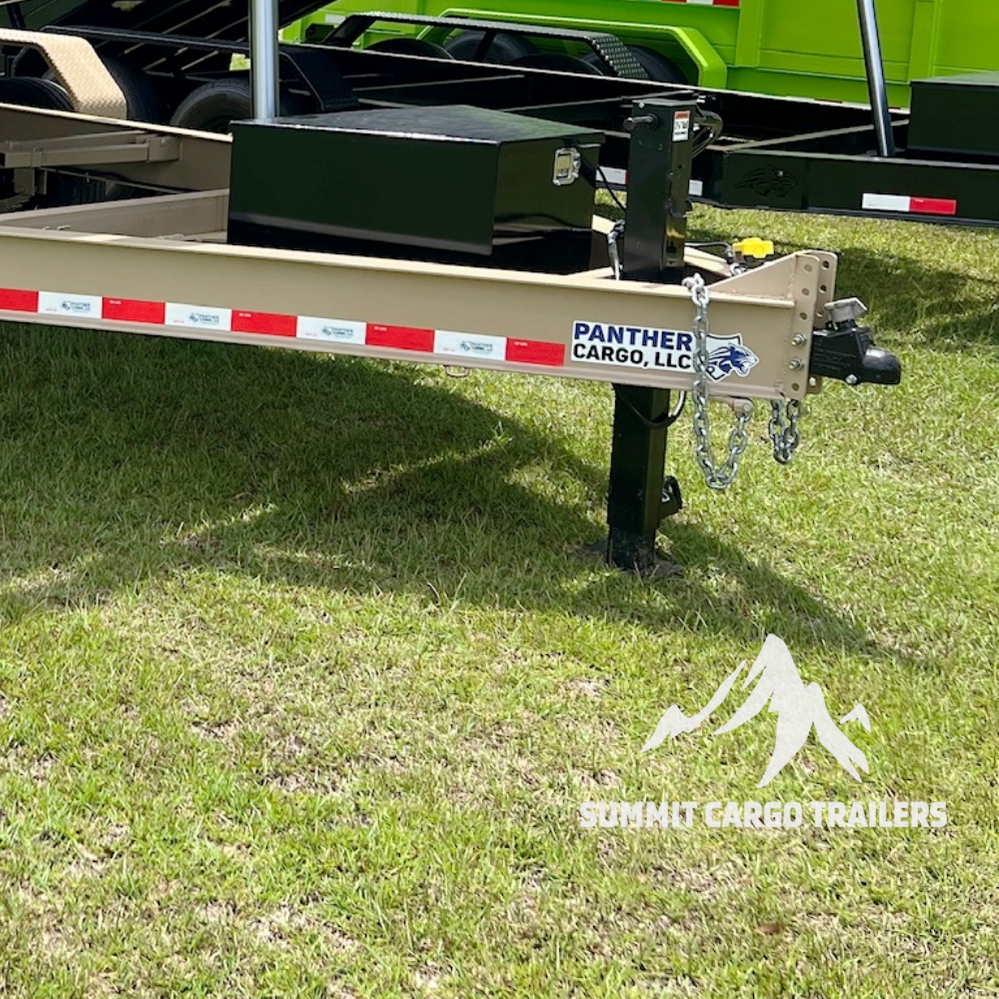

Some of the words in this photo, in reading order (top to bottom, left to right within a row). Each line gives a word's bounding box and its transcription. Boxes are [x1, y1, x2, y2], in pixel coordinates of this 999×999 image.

[574, 322, 693, 352] PANTHER
[573, 343, 648, 367] CARGO,
[654, 352, 692, 370] LLC
